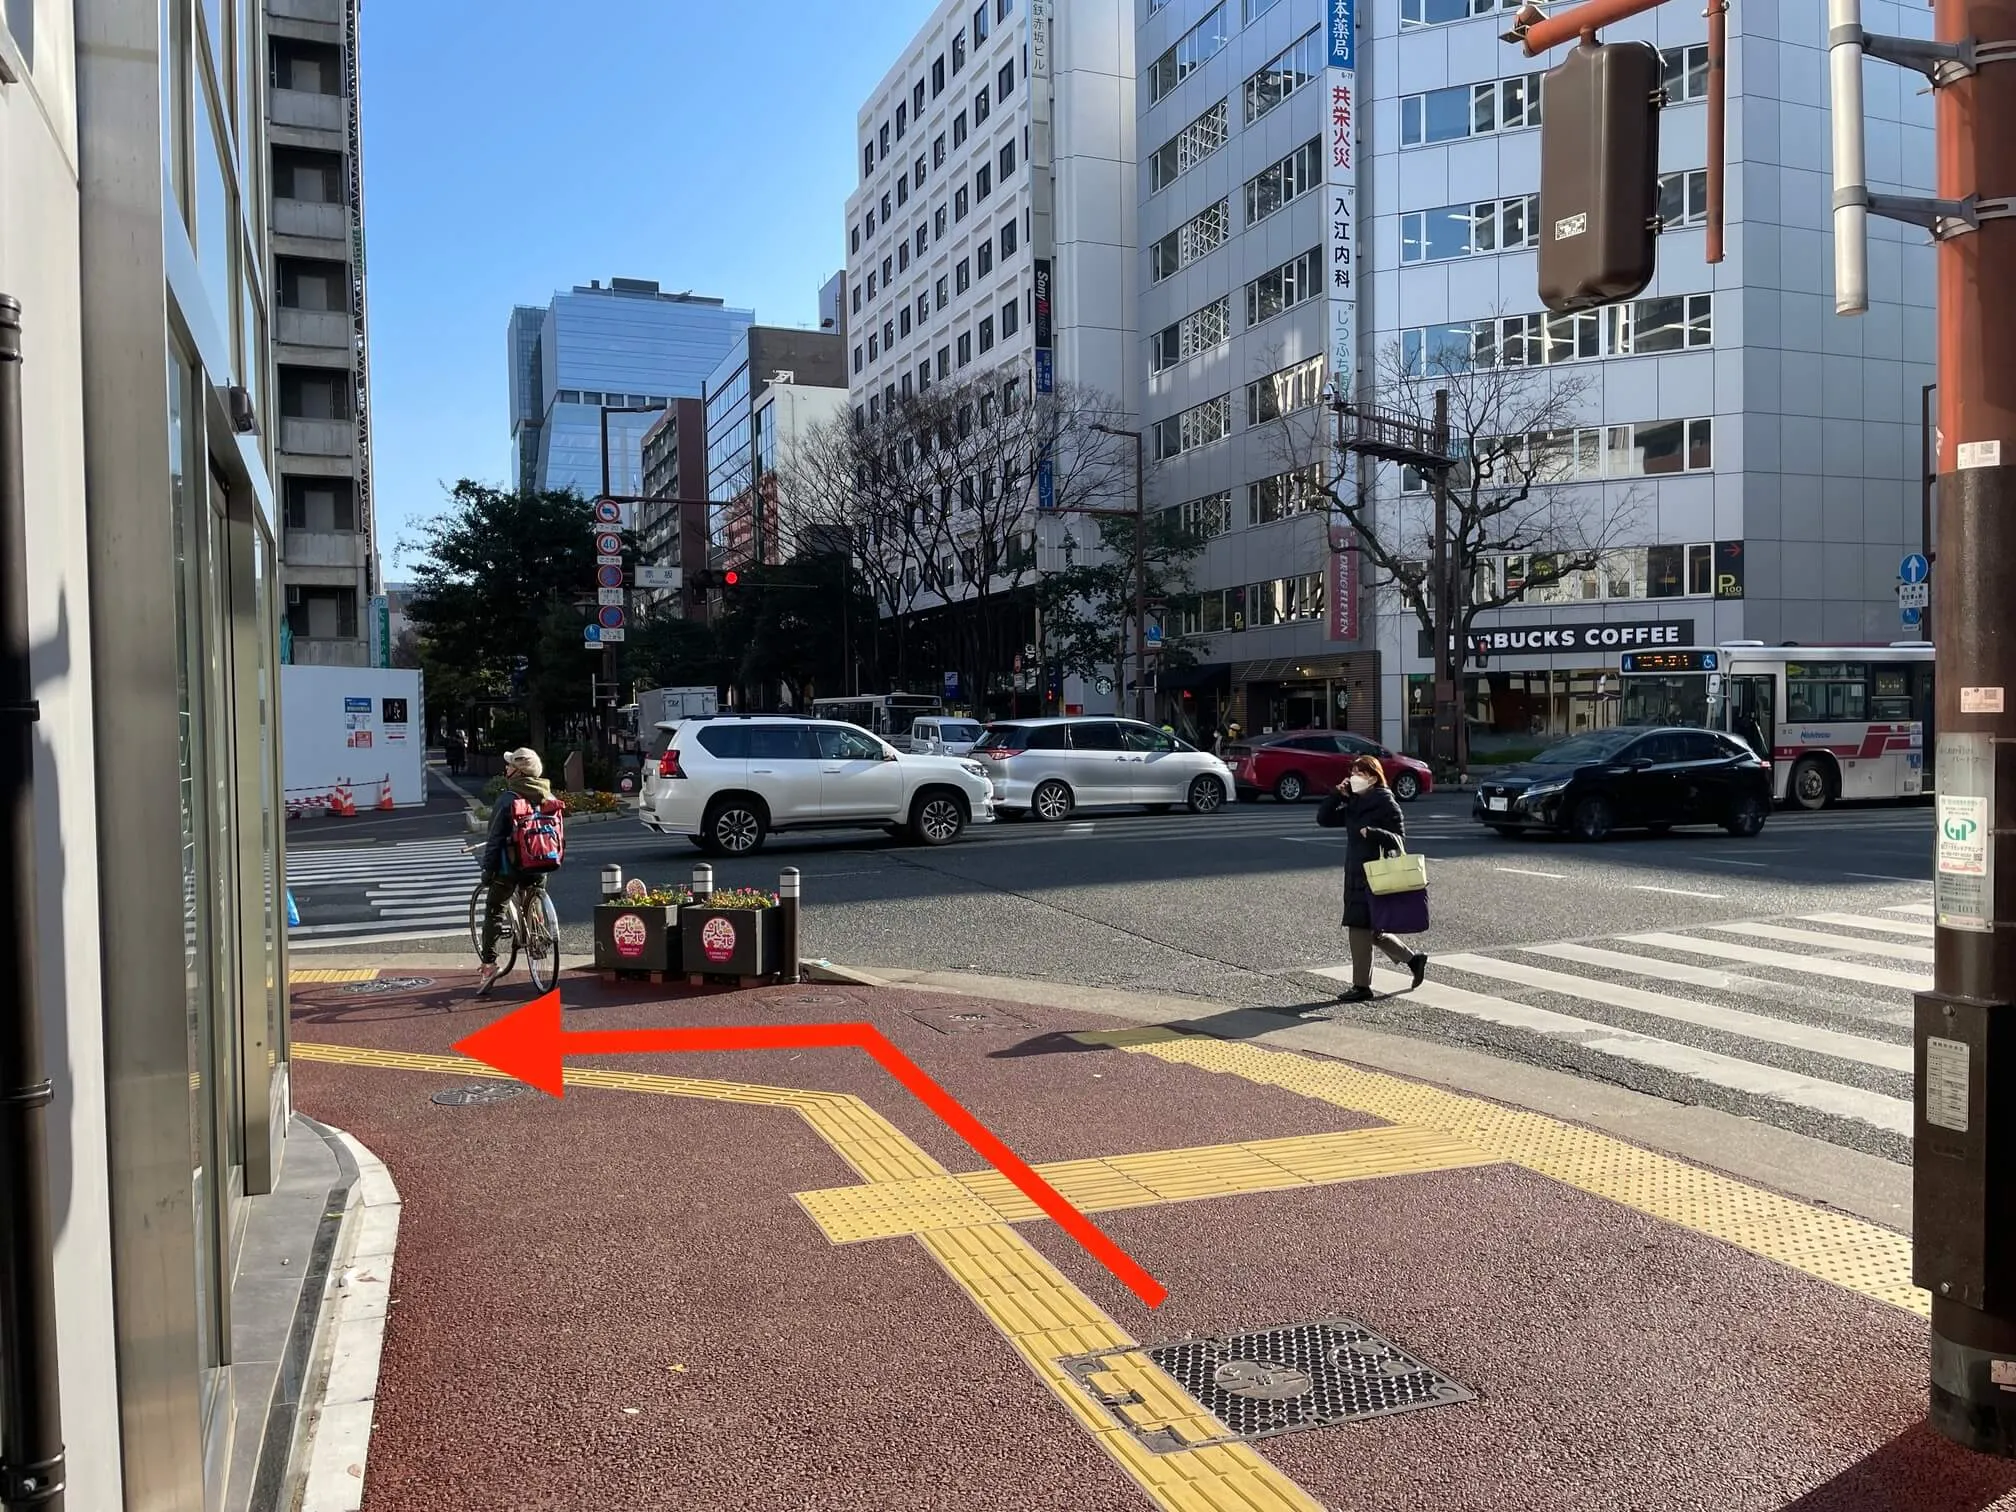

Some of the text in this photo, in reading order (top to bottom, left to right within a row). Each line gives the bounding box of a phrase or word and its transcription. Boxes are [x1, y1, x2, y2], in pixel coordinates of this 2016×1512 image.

[1033, 0, 1045, 70] 鉄赤坂ビル
[1332, 0, 1350, 60] 本薬局
[1332, 85, 1351, 169] 共栄火災
[1334, 197, 1350, 288] 入江内科
[603, 539, 616, 550] 40
[1718, 574, 1736, 593] P
[1585, 627, 1679, 645] COFFEE
